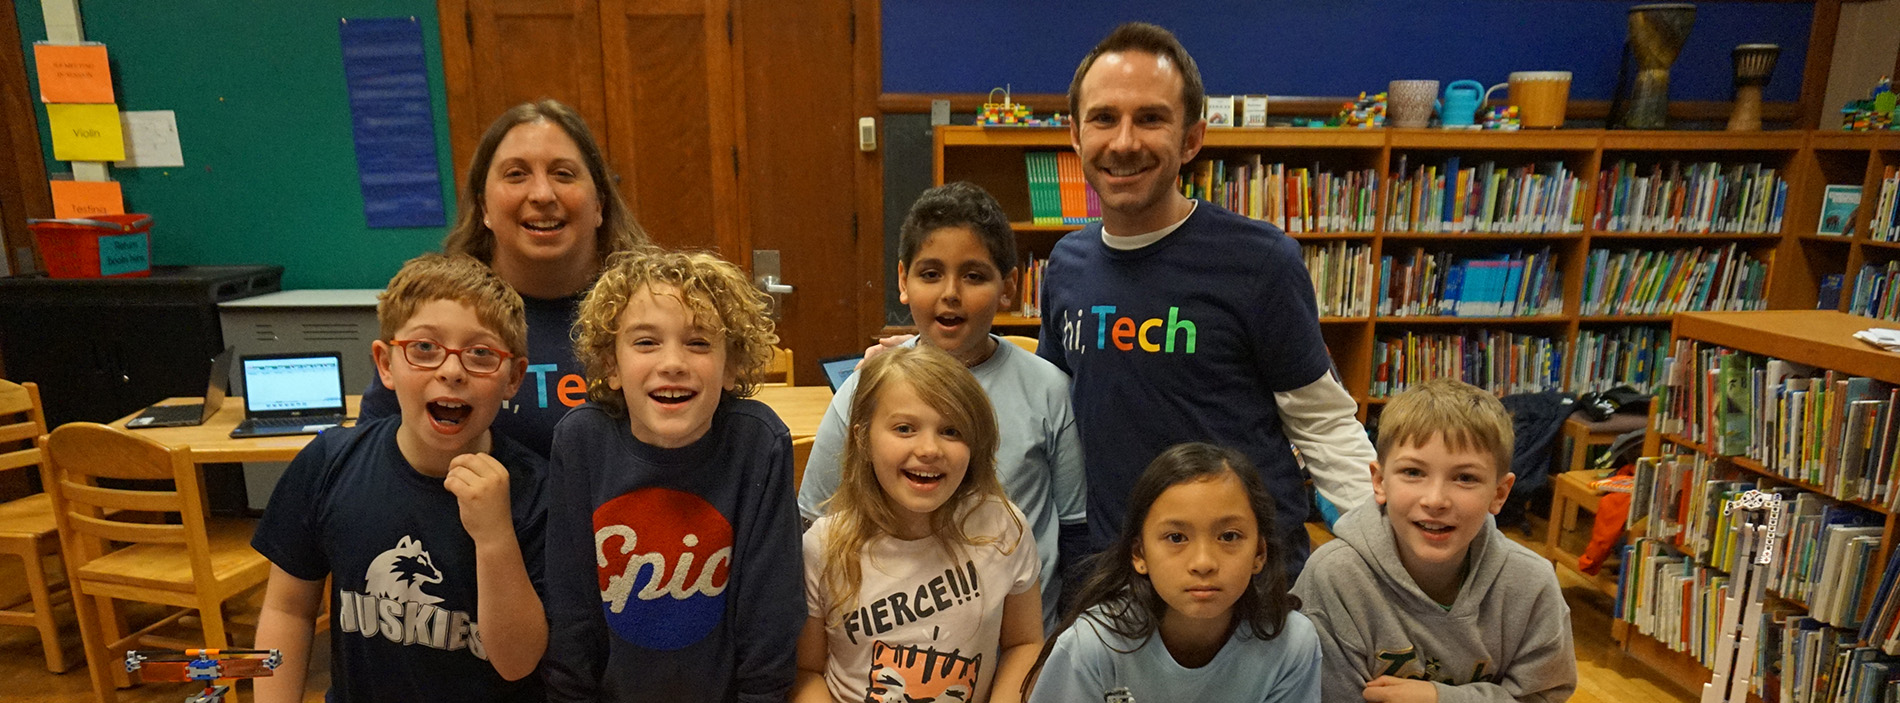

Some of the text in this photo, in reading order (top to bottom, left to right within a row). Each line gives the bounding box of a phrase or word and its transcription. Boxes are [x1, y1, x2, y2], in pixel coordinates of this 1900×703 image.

[72, 127, 101, 138] Violin
[1063, 305, 1197, 355] hi, Tech
[526, 363, 587, 408] Te
[595, 524, 733, 614] Epic
[843, 559, 981, 646] FIERCE!!!
